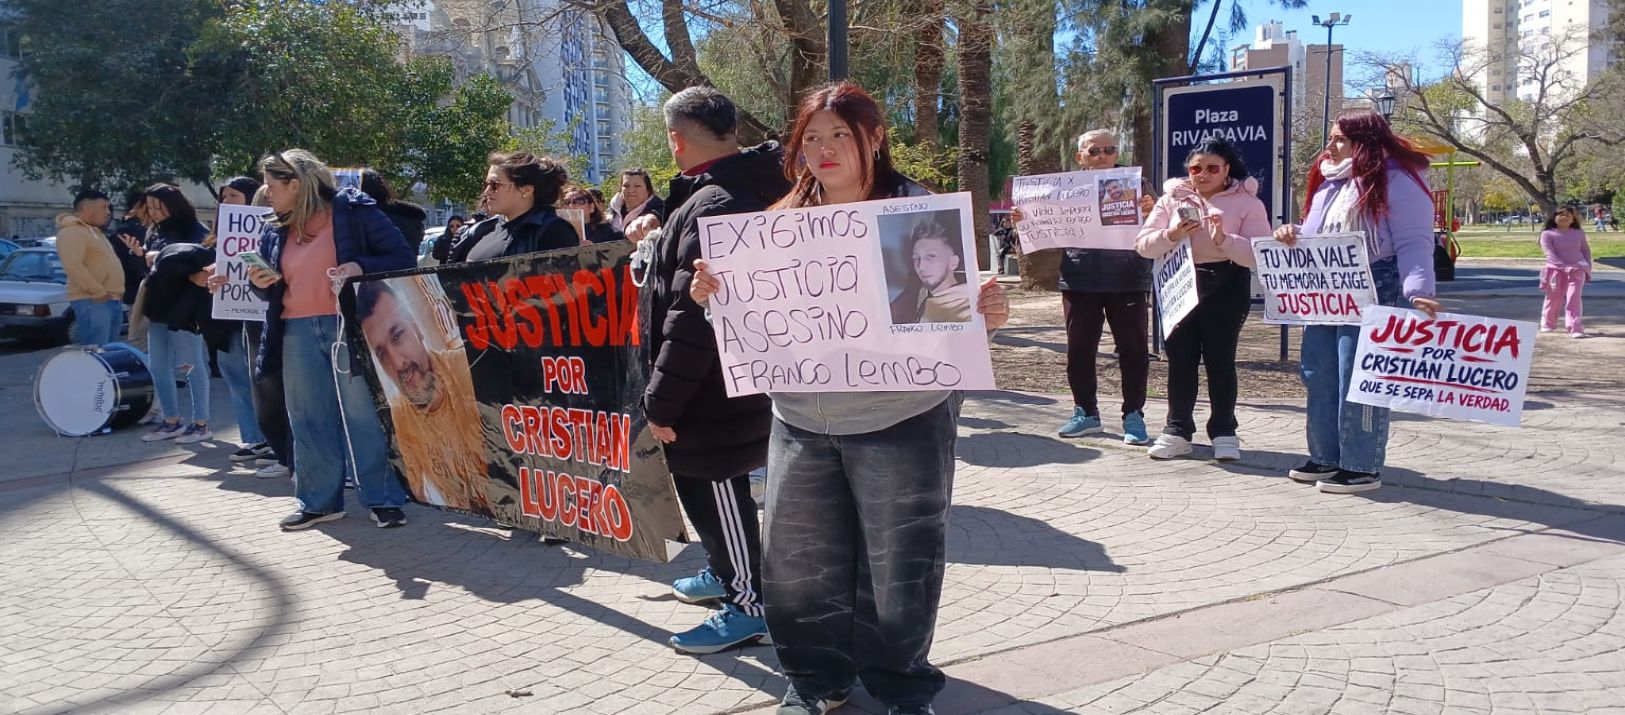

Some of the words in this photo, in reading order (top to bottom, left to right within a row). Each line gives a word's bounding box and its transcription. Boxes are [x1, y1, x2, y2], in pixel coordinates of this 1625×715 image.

[1195, 109, 1238, 124] Plaza
[1172, 125, 1267, 146] RIVADAVIA
[1260, 248, 1280, 269] TU
[1282, 247, 1317, 269] VIDA
[1318, 245, 1359, 268] VALE
[221, 283, 252, 302] POR
[1262, 273, 1278, 290] TU
[1280, 272, 1329, 290] MEMORIA
[1331, 271, 1369, 289] EXIGE
[460, 264, 640, 350] JUSTICIA
[1276, 292, 1360, 316] JUSTICIA
[1370, 314, 1521, 361] JUSTICIA
[1421, 347, 1455, 362] POR
[541, 356, 588, 394] POR
[1361, 352, 1443, 380] CRISTIAN
[1446, 364, 1518, 391] LUCERO
[1359, 380, 1382, 394] QUE
[1385, 383, 1399, 396] SE
[1402, 386, 1434, 401] SEPA
[1437, 390, 1454, 403] LA
[1459, 393, 1511, 413] VERDAD.
[501, 404, 630, 473] CRISTIAN
[519, 467, 634, 542] LUCERO
